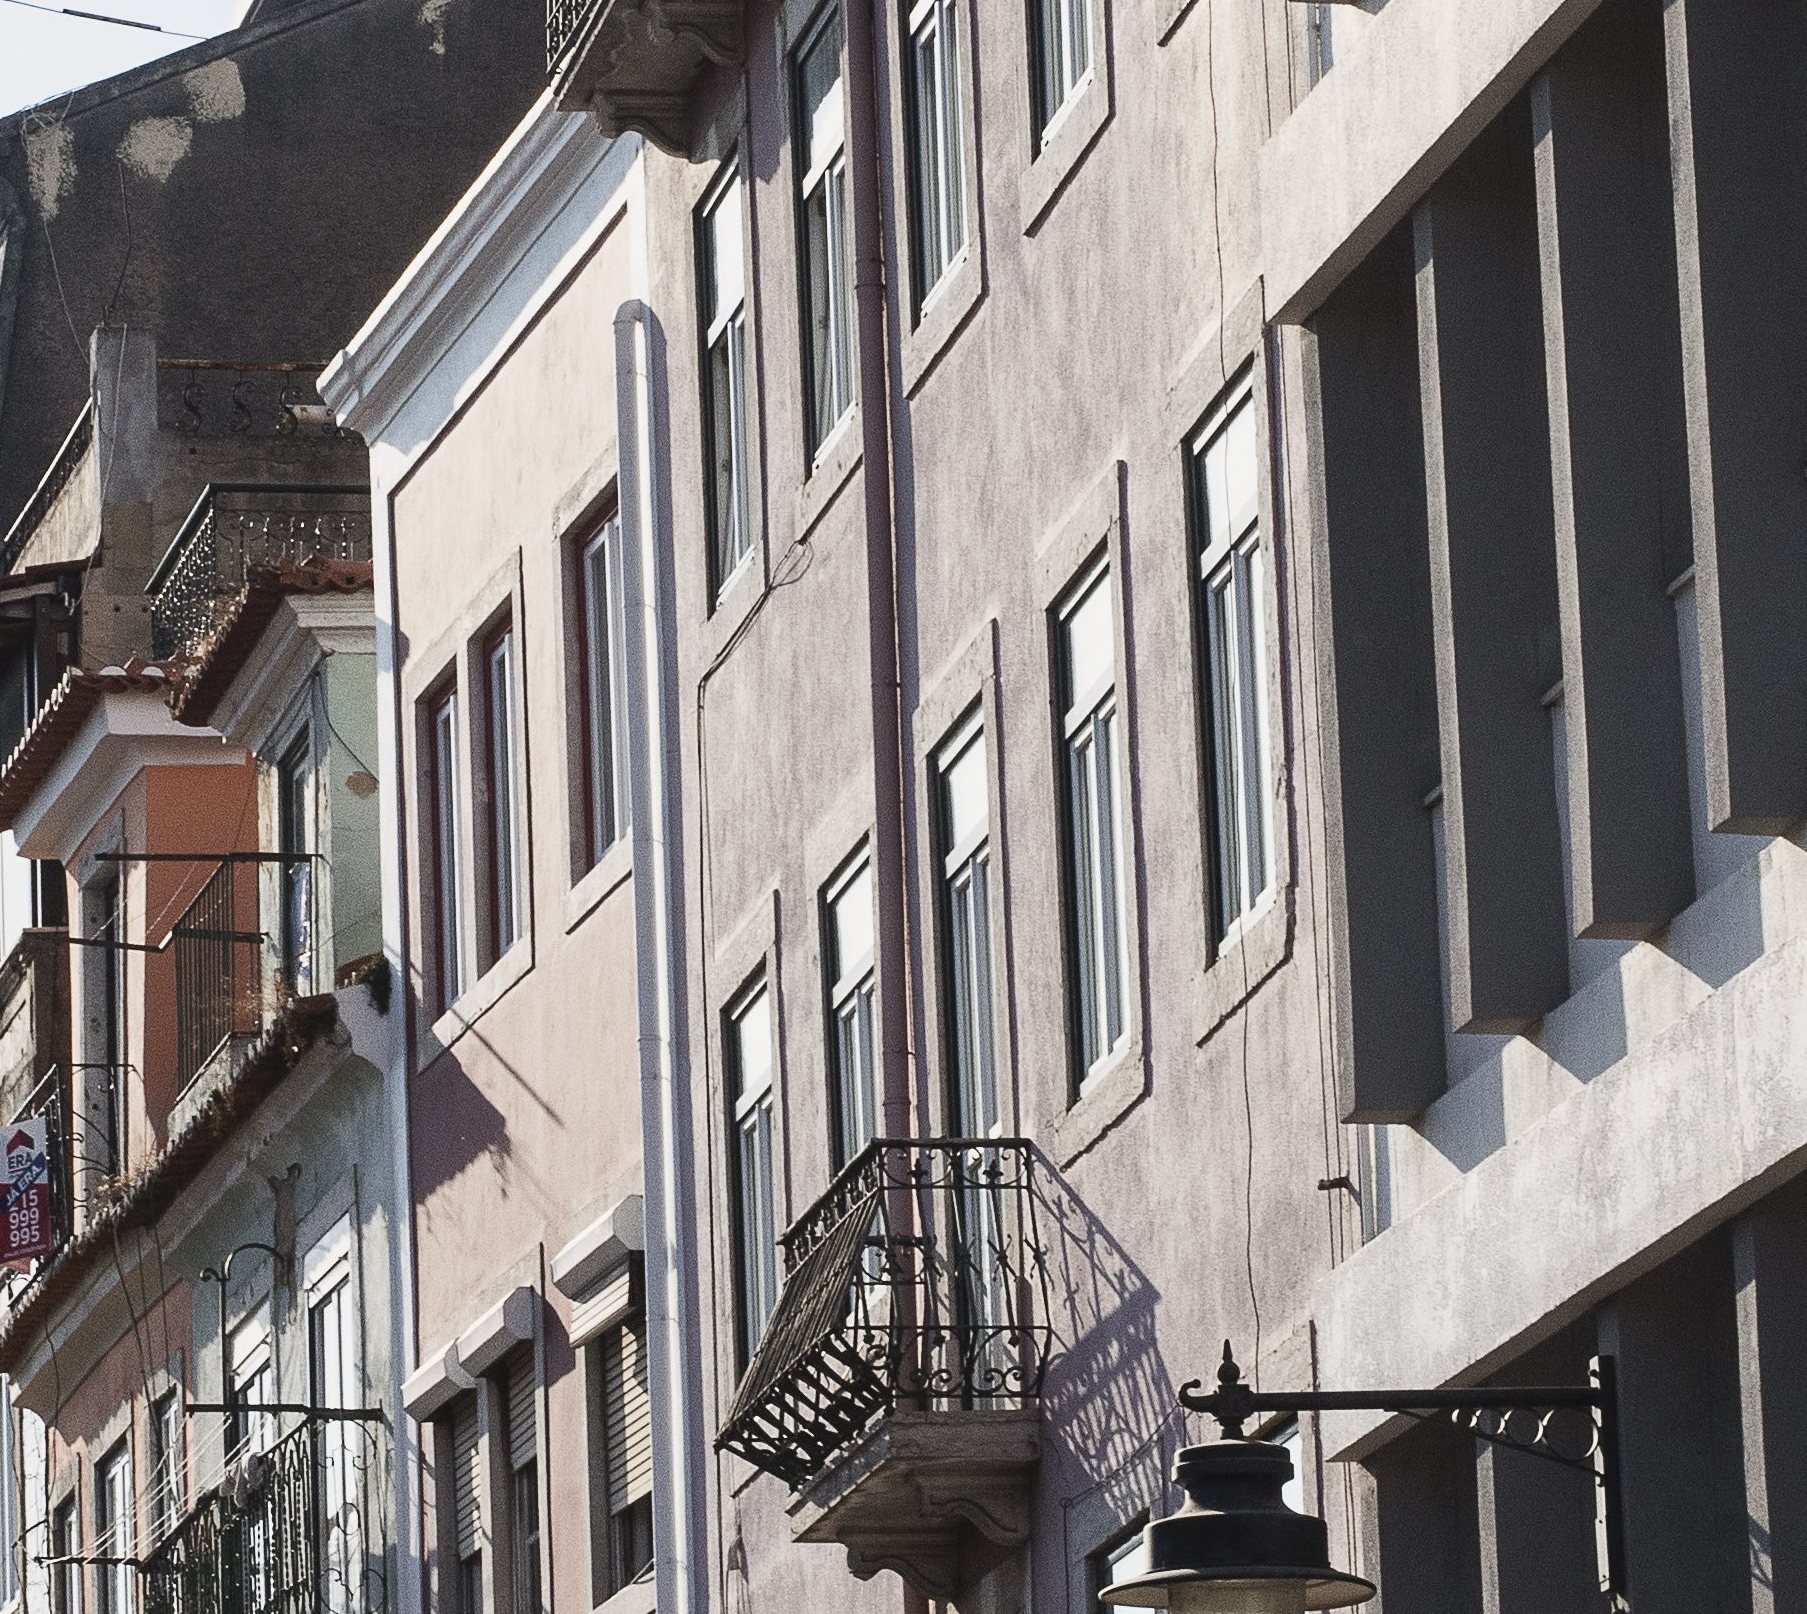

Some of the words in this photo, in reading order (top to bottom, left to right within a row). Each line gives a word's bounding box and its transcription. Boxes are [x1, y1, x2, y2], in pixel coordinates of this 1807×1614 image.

[8, 1152, 33, 1170] ERA
[9, 1207, 39, 1230] 999
[10, 1225, 40, 1248] 995
